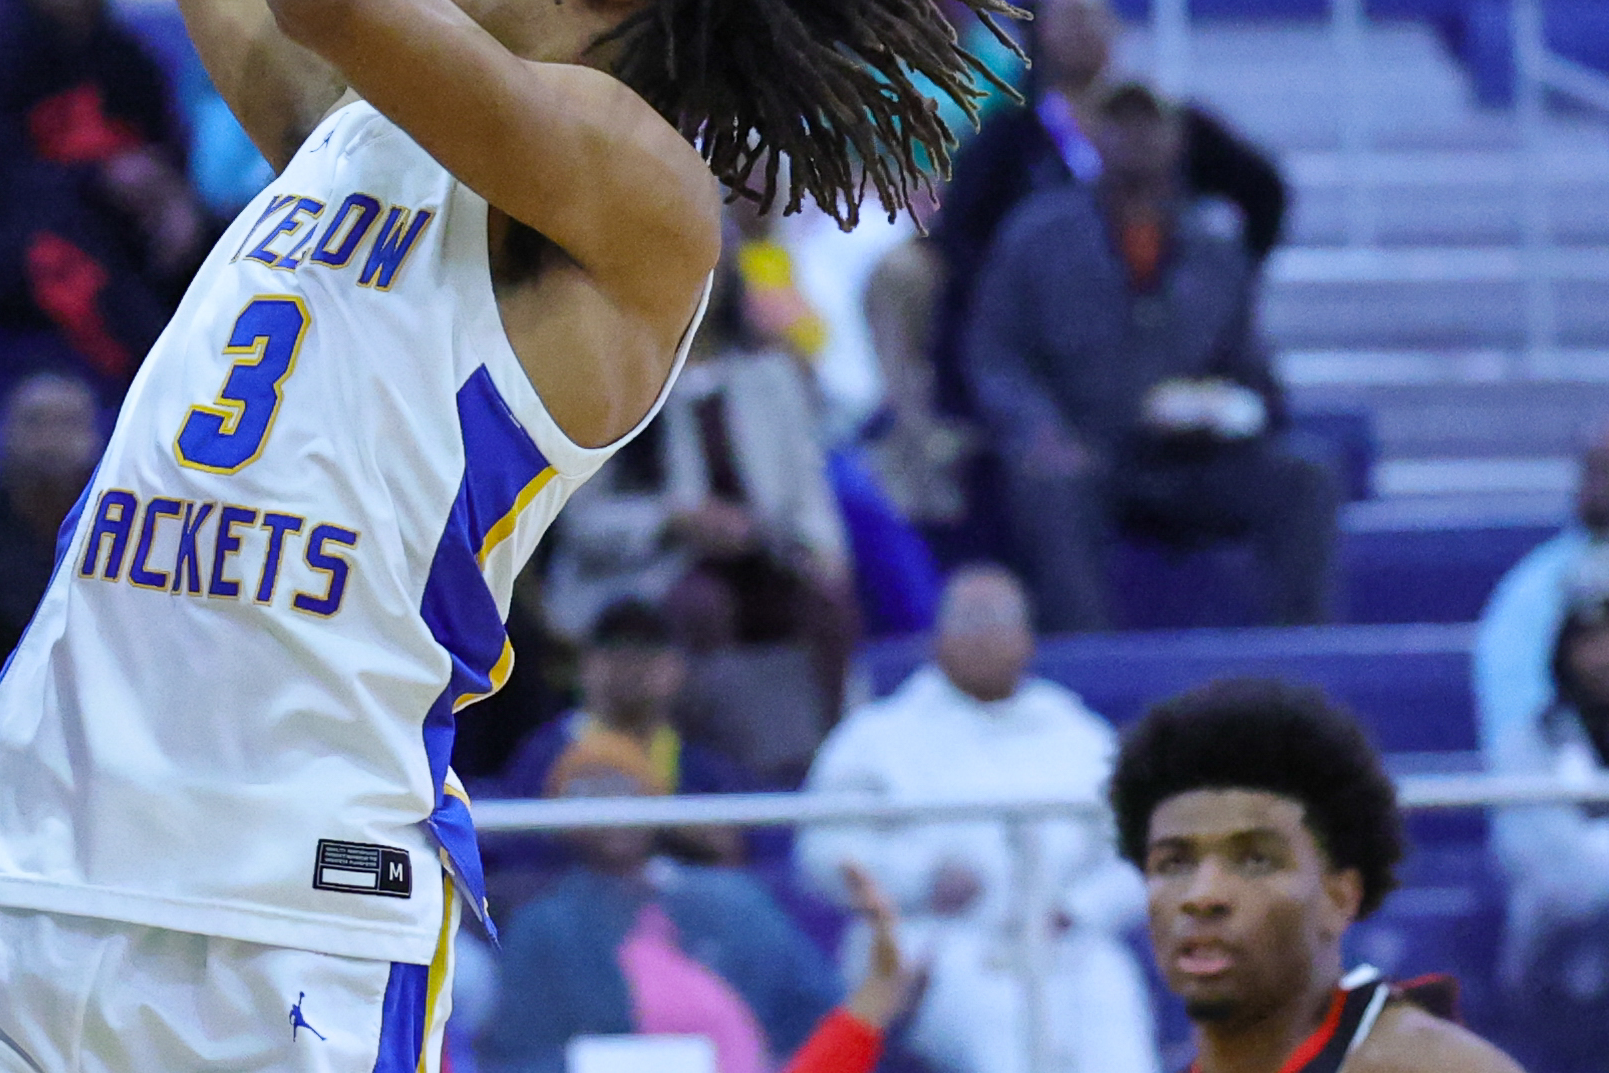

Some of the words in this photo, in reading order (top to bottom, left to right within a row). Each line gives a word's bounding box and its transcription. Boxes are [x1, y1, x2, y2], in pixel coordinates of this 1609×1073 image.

[173, 294, 312, 475] 3
[77, 488, 361, 618] ACKETS
[389, 861, 403, 882] M
